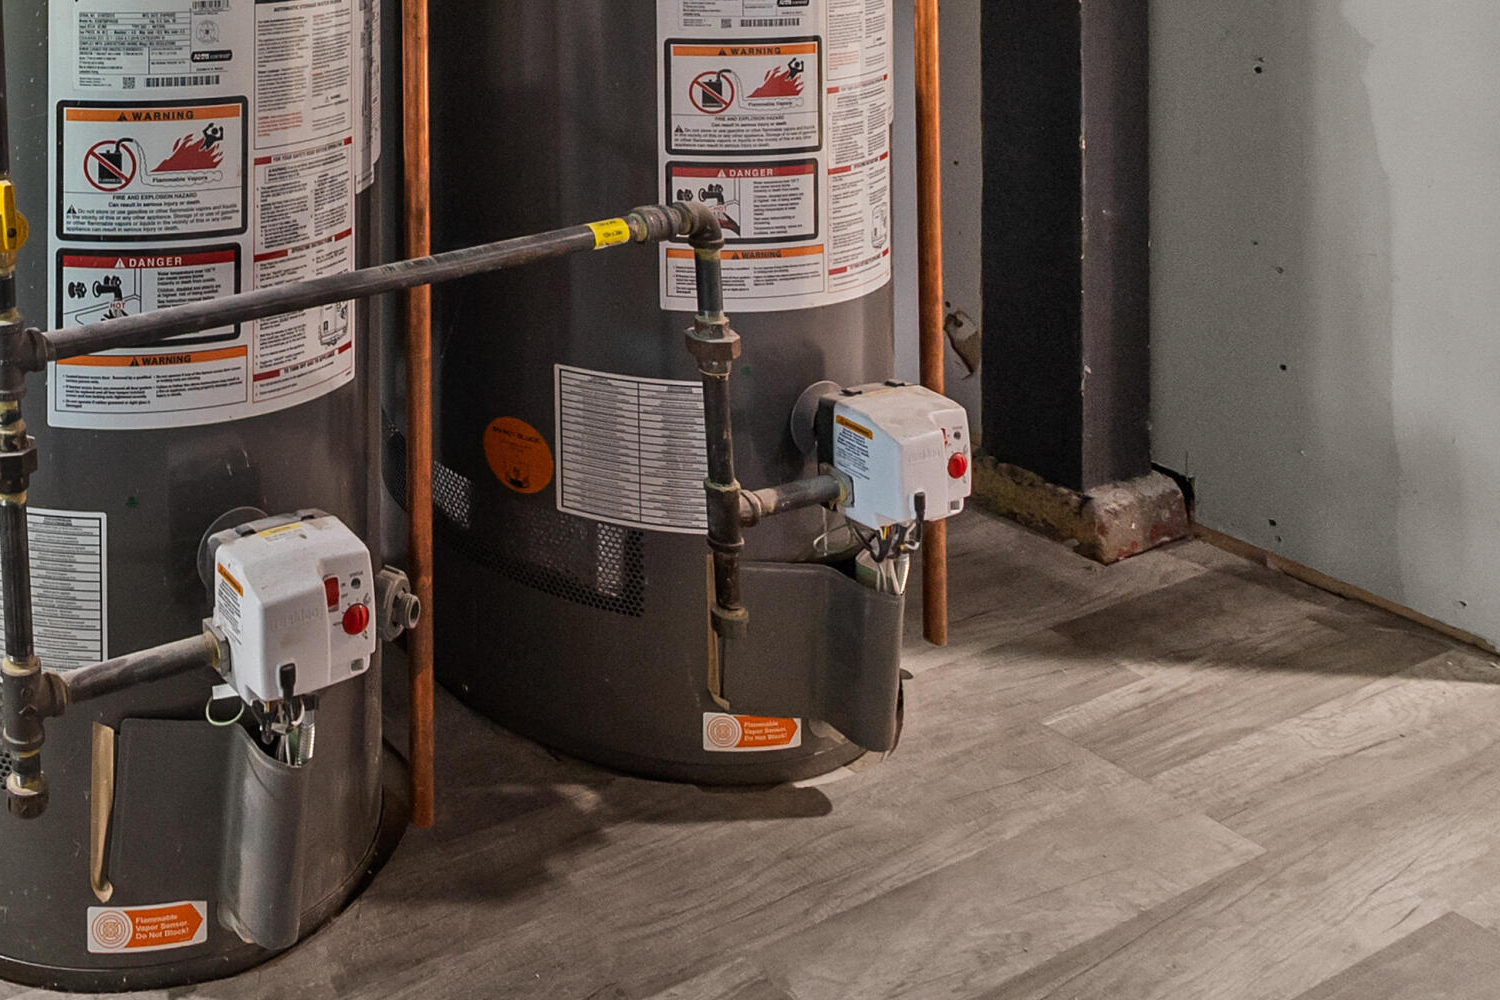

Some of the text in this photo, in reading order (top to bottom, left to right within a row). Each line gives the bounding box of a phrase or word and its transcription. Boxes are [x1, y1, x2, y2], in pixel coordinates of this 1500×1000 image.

[730, 47, 781, 56] WARNING
[132, 110, 194, 121] WARNING
[729, 168, 774, 177] DANGER
[187, 175, 208, 183] Vapors
[741, 250, 782, 259] WARNING
[128, 256, 183, 268] DANGER
[141, 355, 192, 366] WARNING
[744, 720, 778, 728] Flammable
[135, 914, 178, 924] Flammable
[135, 924, 158, 933] Vapor
[135, 926, 189, 940] Do Not Block!
